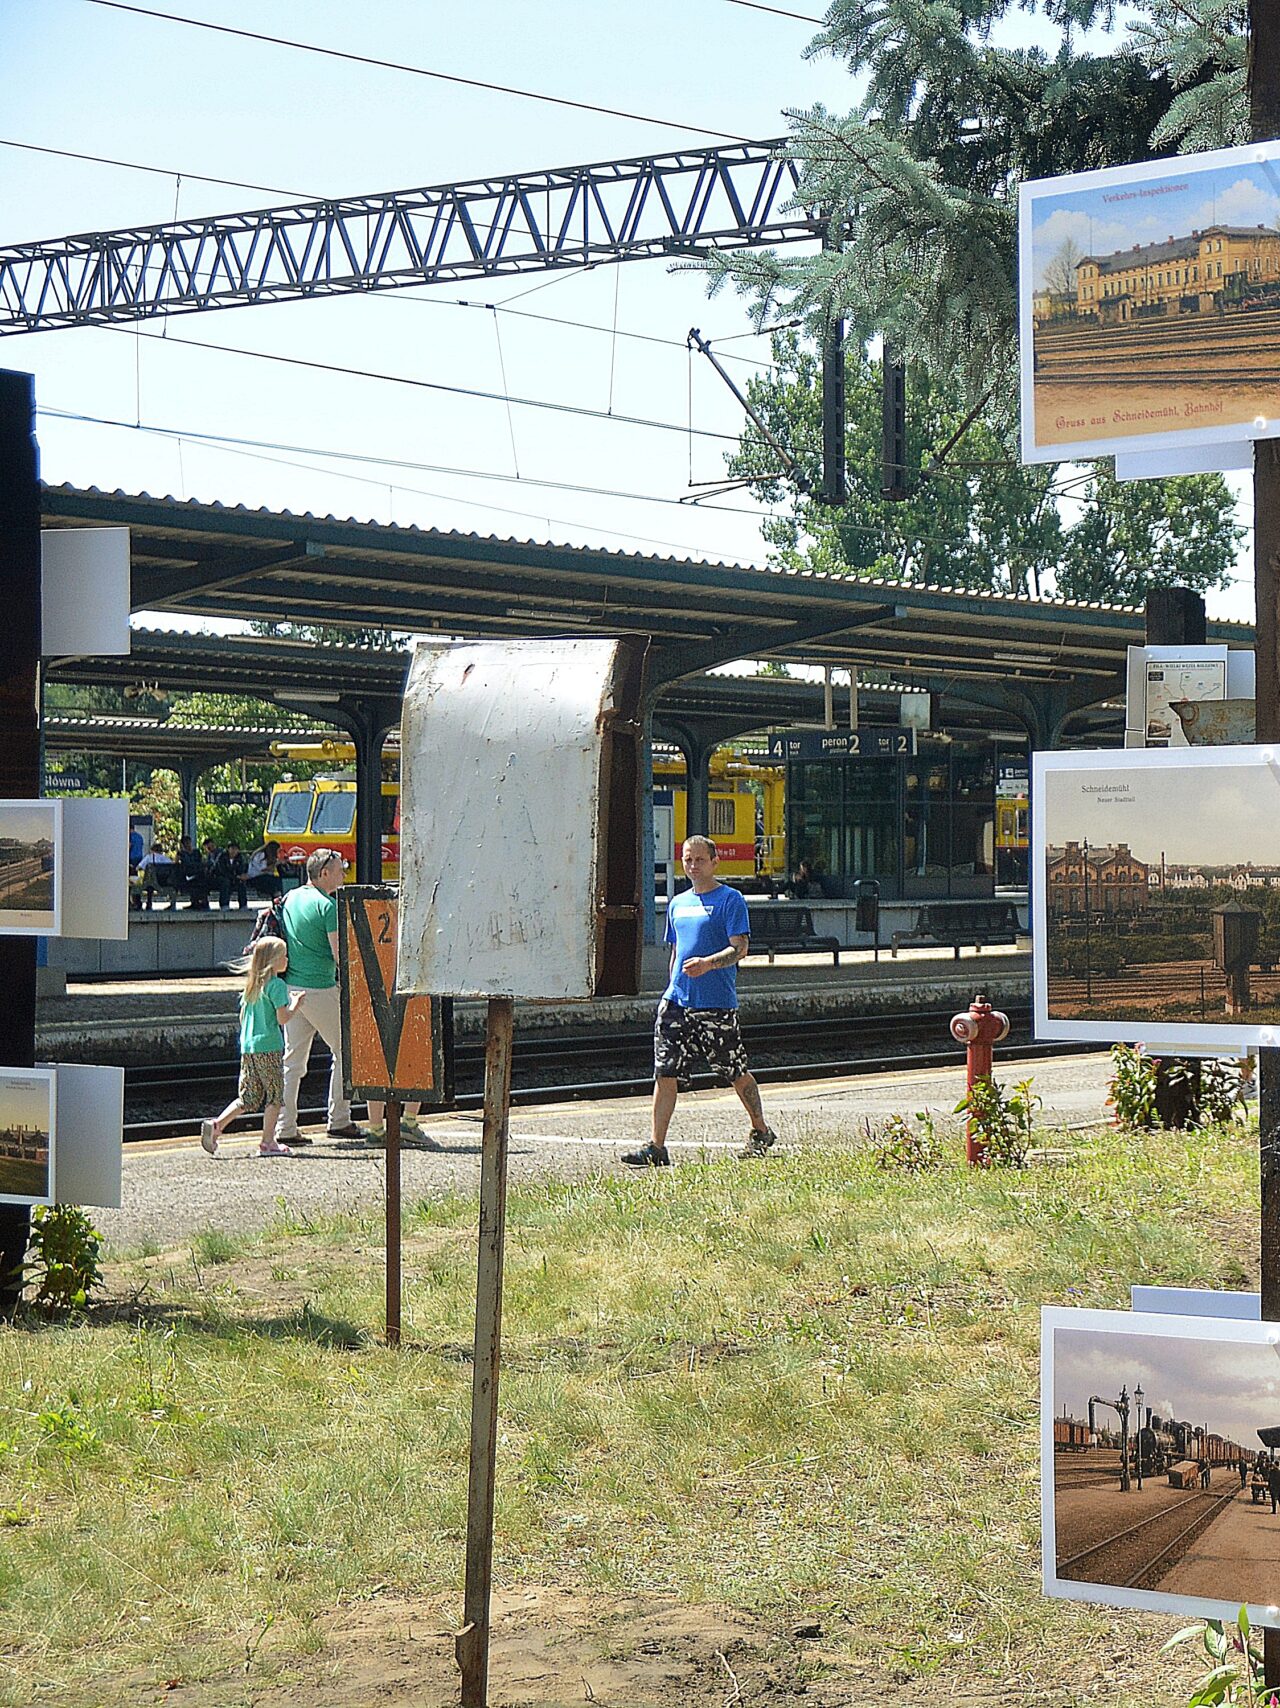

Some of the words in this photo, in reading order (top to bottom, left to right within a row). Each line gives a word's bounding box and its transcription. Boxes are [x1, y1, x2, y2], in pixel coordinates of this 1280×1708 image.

[1055, 415, 1086, 430] Gruss
[1090, 416, 1106, 426] aus
[1184, 400, 1224, 417] Bahnhof
[773, 740, 783, 757] 4
[789, 741, 800, 749] tor
[822, 737, 848, 749] peron
[849, 734, 860, 754] 2
[878, 738, 890, 746] tor
[897, 735, 907, 752] 2
[1081, 784, 1130, 793] Schneidemühl
[378, 911, 392, 944] 2
